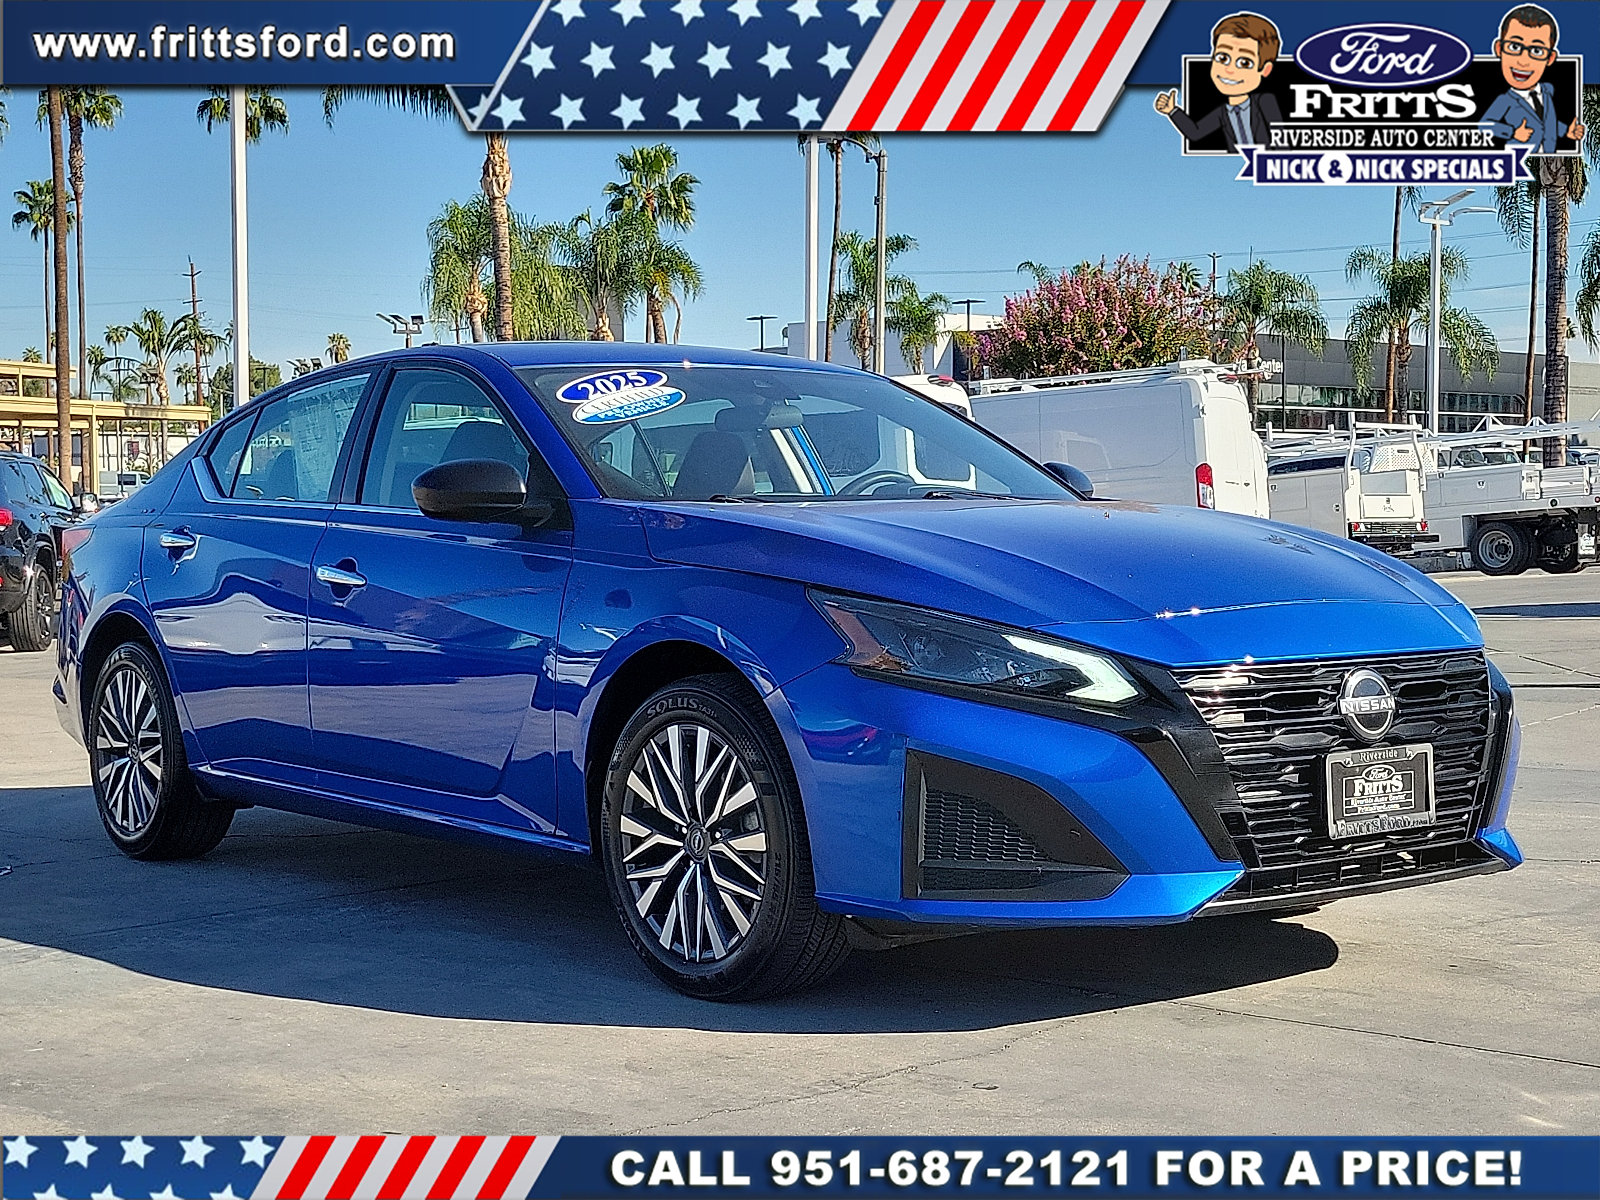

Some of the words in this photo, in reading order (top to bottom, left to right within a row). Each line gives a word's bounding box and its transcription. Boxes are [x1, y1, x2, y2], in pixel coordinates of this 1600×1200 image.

[577, 371, 648, 401] 2025
[647, 697, 699, 719] SOLUS
[1341, 697, 1395, 713] NISSAN
[1360, 749, 1398, 762] Riverside
[1368, 768, 1389, 780] Ford
